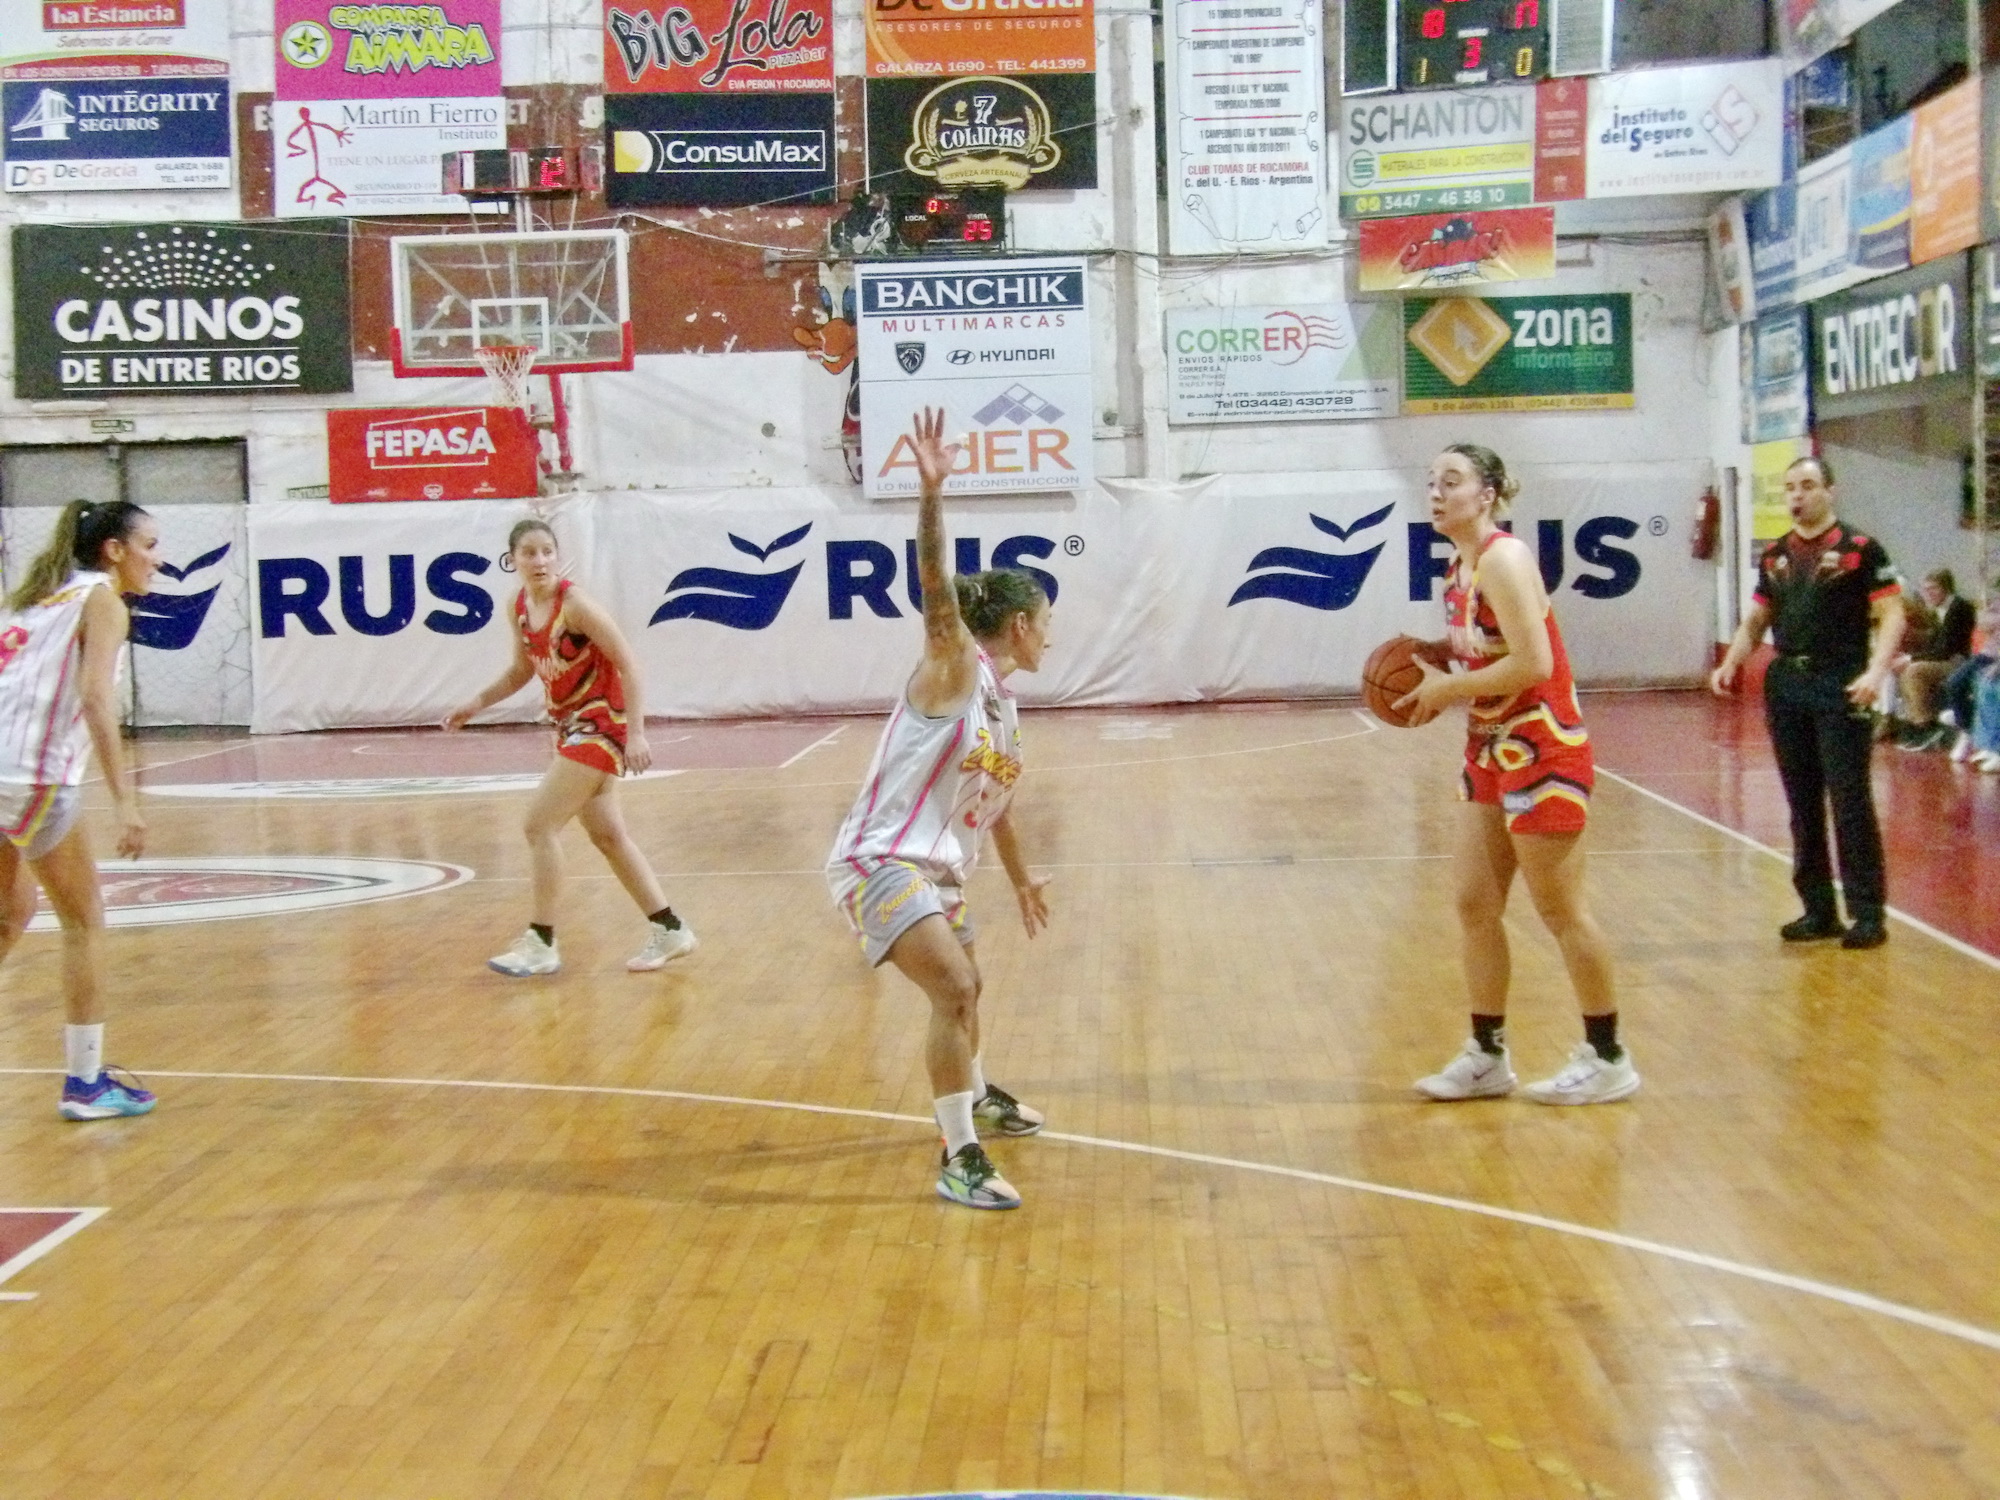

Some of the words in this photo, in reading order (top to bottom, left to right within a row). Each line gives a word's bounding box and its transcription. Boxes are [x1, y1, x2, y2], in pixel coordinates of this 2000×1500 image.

[52, 7, 79, 24] La
[83, 4, 176, 24] Estancia
[329, 5, 448, 30] COMPARSA
[1243, 7, 1282, 18] PROVINCIALES
[875, 22, 962, 32] ASESORES
[974, 21, 993, 31] DE
[1005, 19, 1083, 30] SEGUROS
[700, 0, 822, 86] Lola
[1192, 39, 1229, 50] CAMPEONATO
[1231, 39, 1261, 48] ARGENTINO
[1262, 38, 1270, 47] DE
[1463, 37, 1482, 69] 3
[1515, 47, 1533, 76] 0
[876, 62, 943, 74] GALARZA
[948, 60, 985, 72] 1690
[996, 60, 1026, 71] TEL:
[1030, 58, 1087, 70] 441399
[728, 80, 746, 90] EVA
[747, 80, 776, 89] PERON
[776, 79, 783, 89] Y
[784, 79, 832, 89] ROCAMORA
[341, 103, 421, 126] Martín
[430, 101, 498, 124] Fierro
[973, 95, 998, 124] 7
[1215, 99, 1248, 109] TEMPORADA
[78, 117, 160, 132] SEGUROS
[1349, 94, 1524, 146] SCHANTON
[438, 128, 498, 141] Instituto
[939, 126, 1027, 149] COLINAS
[1205, 129, 1241, 139] CAMPEONATO
[1601, 127, 1627, 144] del
[1630, 125, 1694, 152] Seguro
[327, 156, 362, 167] TIENE
[365, 156, 383, 166] UN
[387, 154, 429, 165] LUGAR
[666, 140, 822, 164] ConsuMax
[1188, 164, 1211, 175] CLUB
[1213, 163, 1244, 174] TOMAS
[1246, 163, 1258, 173] DE
[1260, 161, 1310, 172] ROCAMORA
[1381, 159, 1426, 172] MATERIALES
[1451, 156, 1462, 167] LA
[944, 169, 979, 180] CERVEZA
[980, 168, 1024, 179] ARTESANAL
[1184, 178, 1194, 188] C.
[1196, 177, 1210, 187] del
[1212, 177, 1222, 187] U.
[1230, 176, 1239, 186] E.
[1241, 176, 1260, 186] Rios
[1269, 174, 1313, 187] Argentina
[1384, 193, 1422, 210] 3447
[1463, 189, 1482, 204] 38
[1487, 187, 1505, 202] 10
[963, 219, 993, 241] 25
[876, 275, 1069, 309] BANCHIK
[55, 295, 304, 343] CASINOS
[882, 314, 1066, 333] MULTIMARCAS
[1513, 306, 1614, 348] zona
[1175, 327, 1303, 354] CORRER
[980, 348, 1055, 363] HYUNDAI
[1178, 356, 1214, 365] ENVIOS
[1220, 354, 1263, 363] RAPIDOS
[61, 358, 102, 384] DE
[111, 356, 212, 383] ENTRE
[222, 354, 301, 382] RIOS
[1216, 399, 1233, 409] Tel
[1236, 398, 1293, 409] (03442)
[1296, 396, 1354, 406] 430729
[1442, 402, 1454, 411] de
[365, 427, 497, 458] FEPASA
[877, 482, 895, 492] LO
[949, 480, 967, 489] EN
[258, 552, 494, 639] RUS
